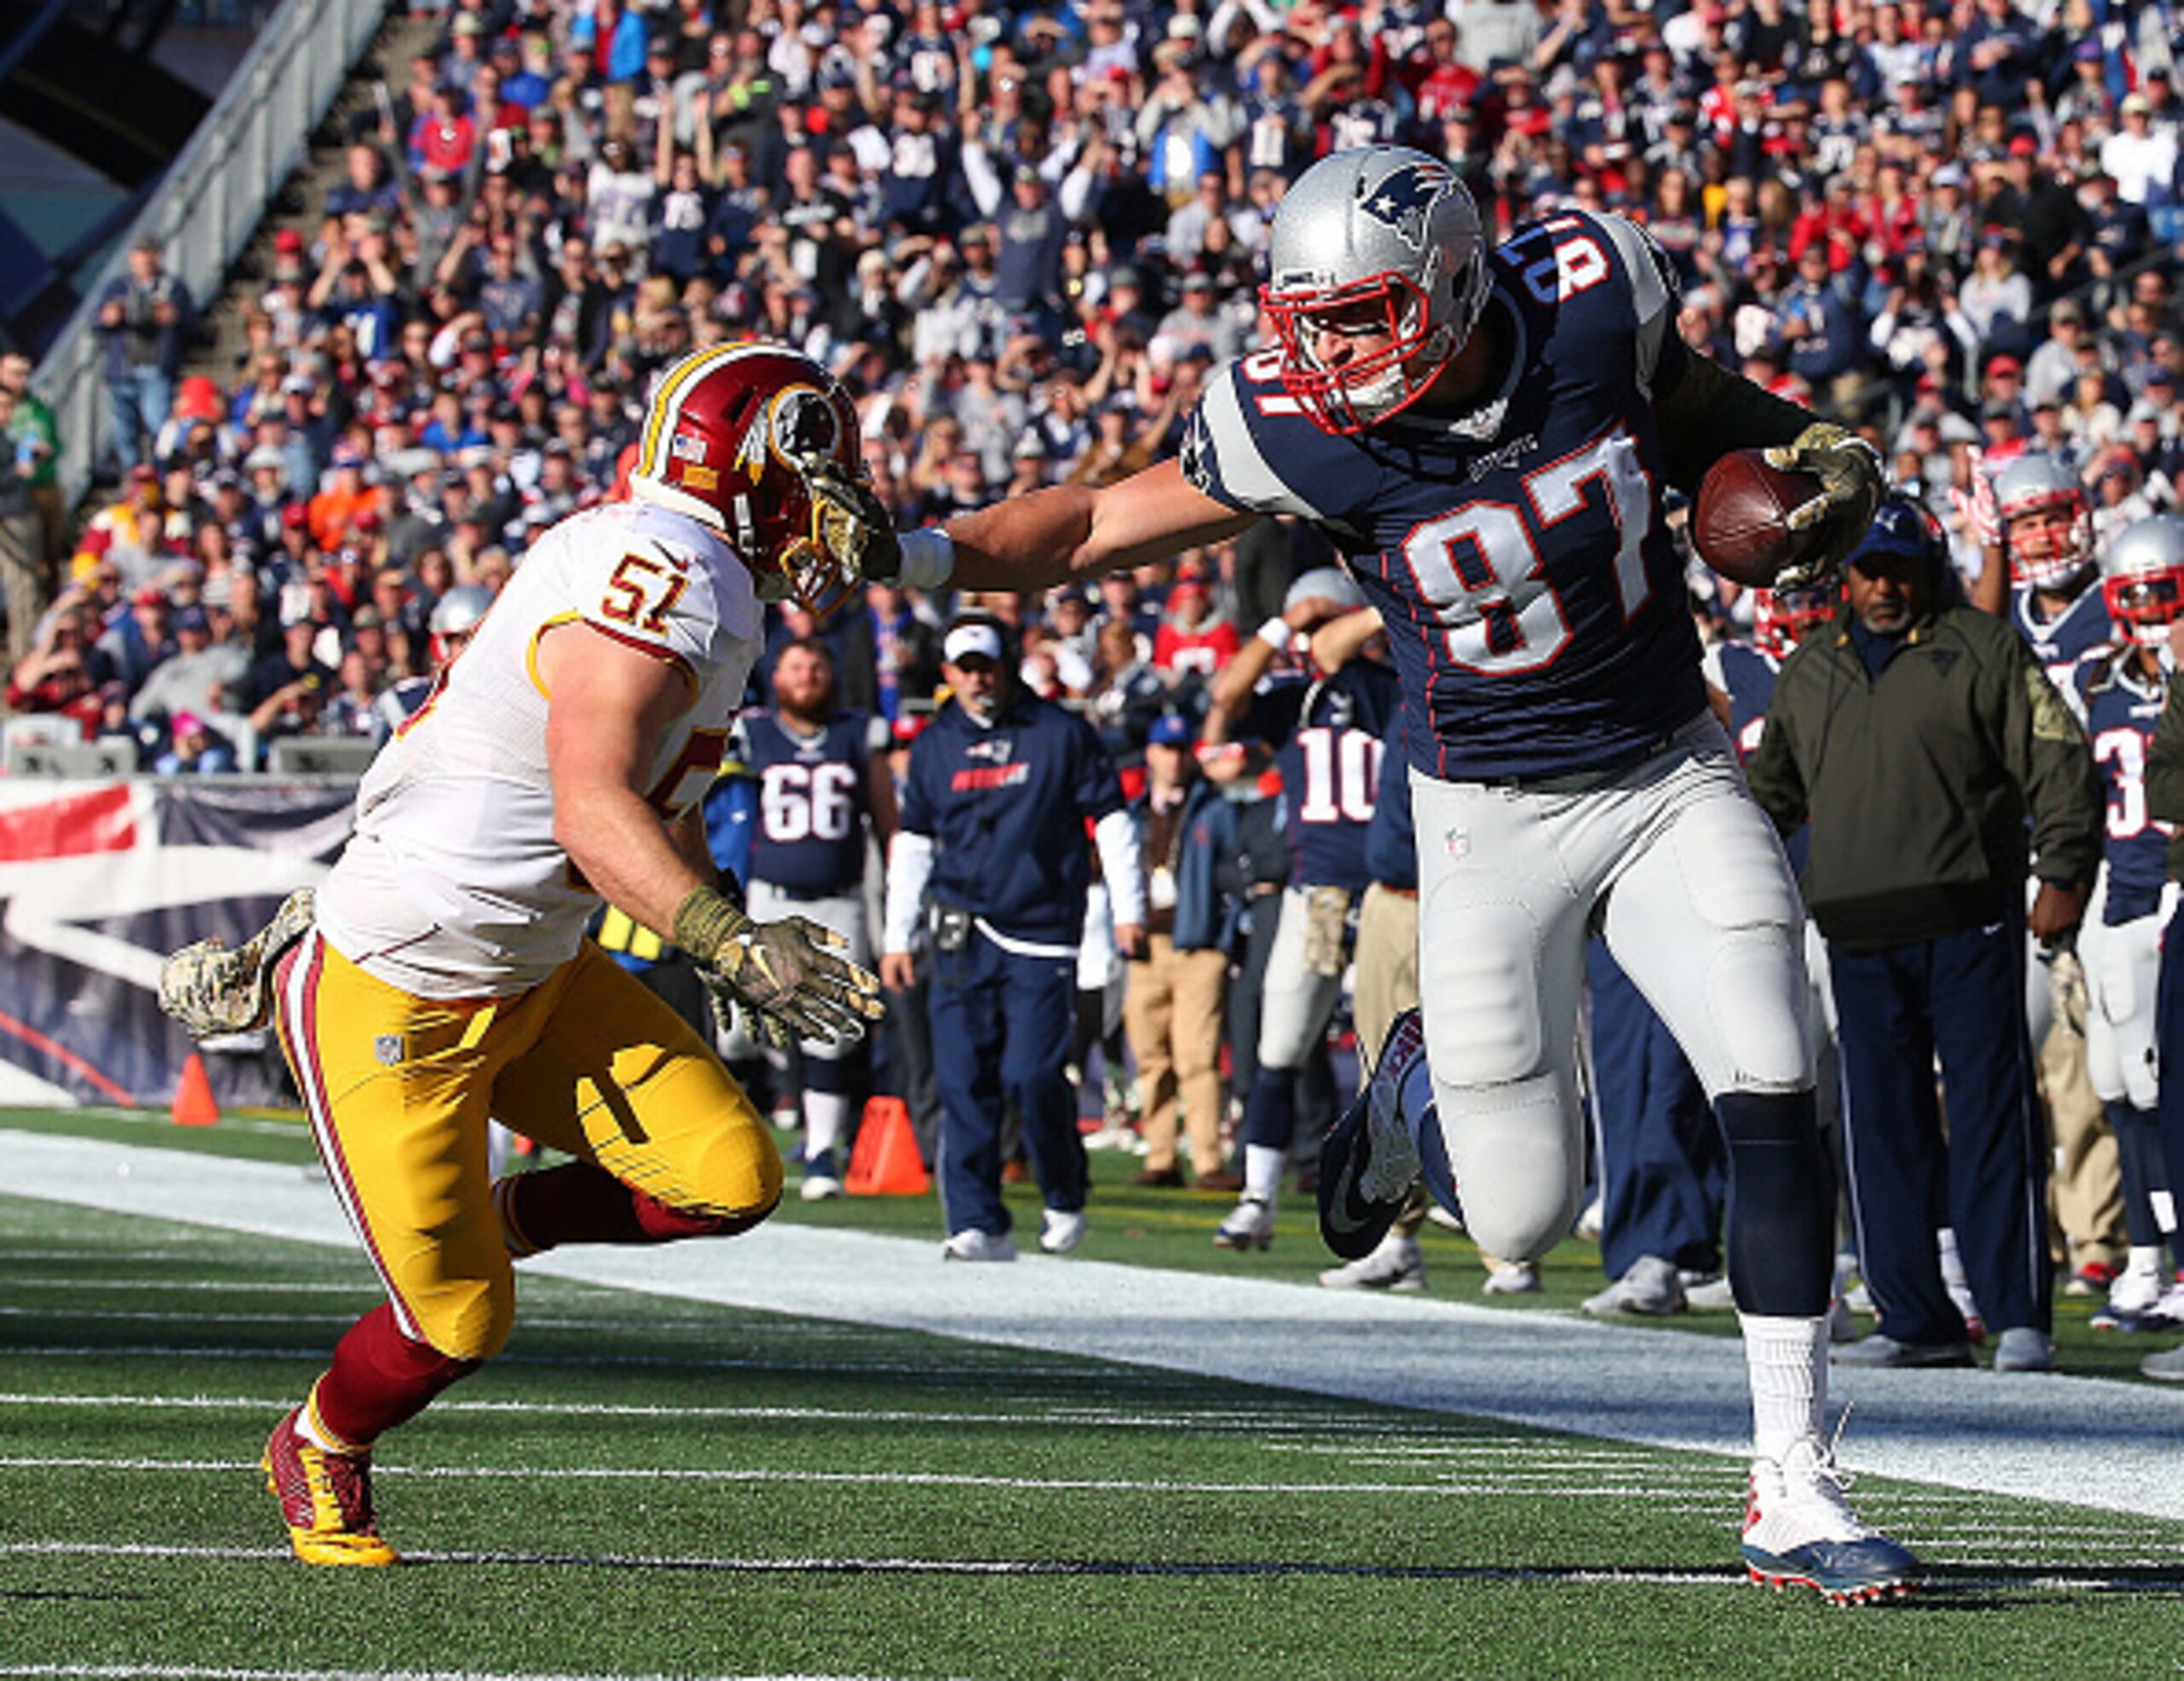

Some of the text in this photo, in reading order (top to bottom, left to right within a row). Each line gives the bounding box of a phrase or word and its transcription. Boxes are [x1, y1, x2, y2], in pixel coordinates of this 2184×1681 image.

[601, 550, 688, 637] 51
[1400, 419, 1653, 676] 87
[761, 762, 857, 841] 66
[1296, 726, 1385, 824] 10
[2094, 727, 2175, 840] 3
